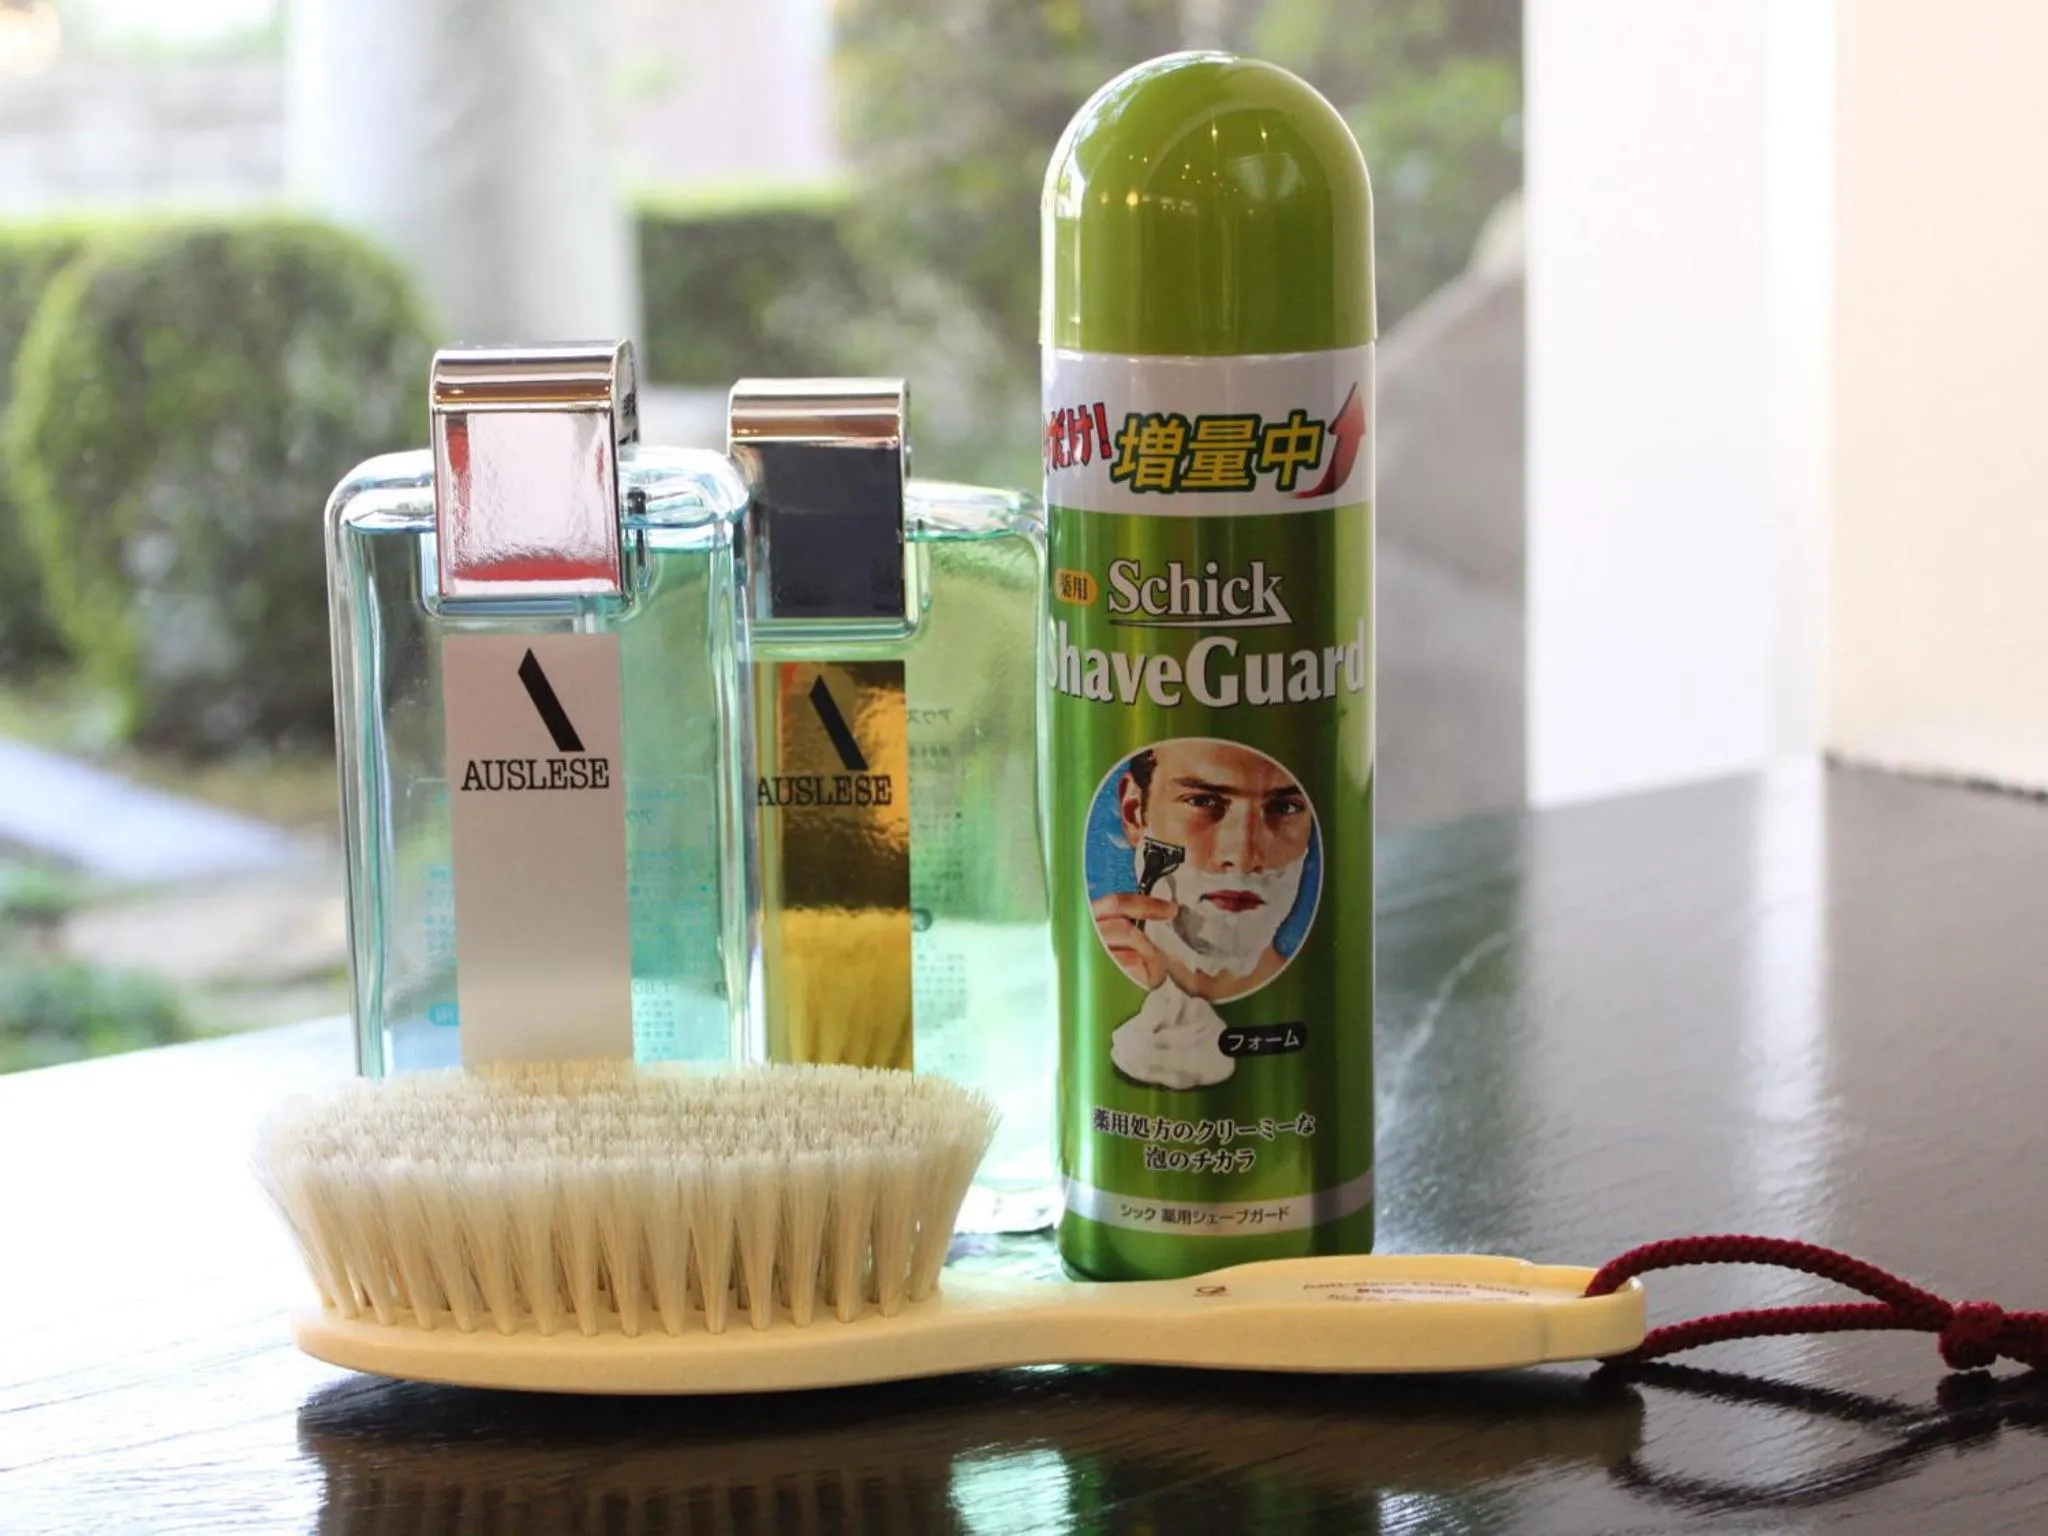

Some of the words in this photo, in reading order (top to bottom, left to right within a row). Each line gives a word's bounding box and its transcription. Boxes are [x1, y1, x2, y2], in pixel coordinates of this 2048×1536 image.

[1110, 410, 1326, 494] 増量中
[1108, 559, 1293, 628] Schick
[461, 758, 609, 791] AUSLESE
[757, 775, 892, 807] AUSLESE
[1227, 1029, 1299, 1051] フォーム
[1093, 1107, 1316, 1144] 薬用処方のクリーミーな
[1145, 1146, 1256, 1173] 泡のチカラ
[1121, 1204, 1156, 1221] シック
